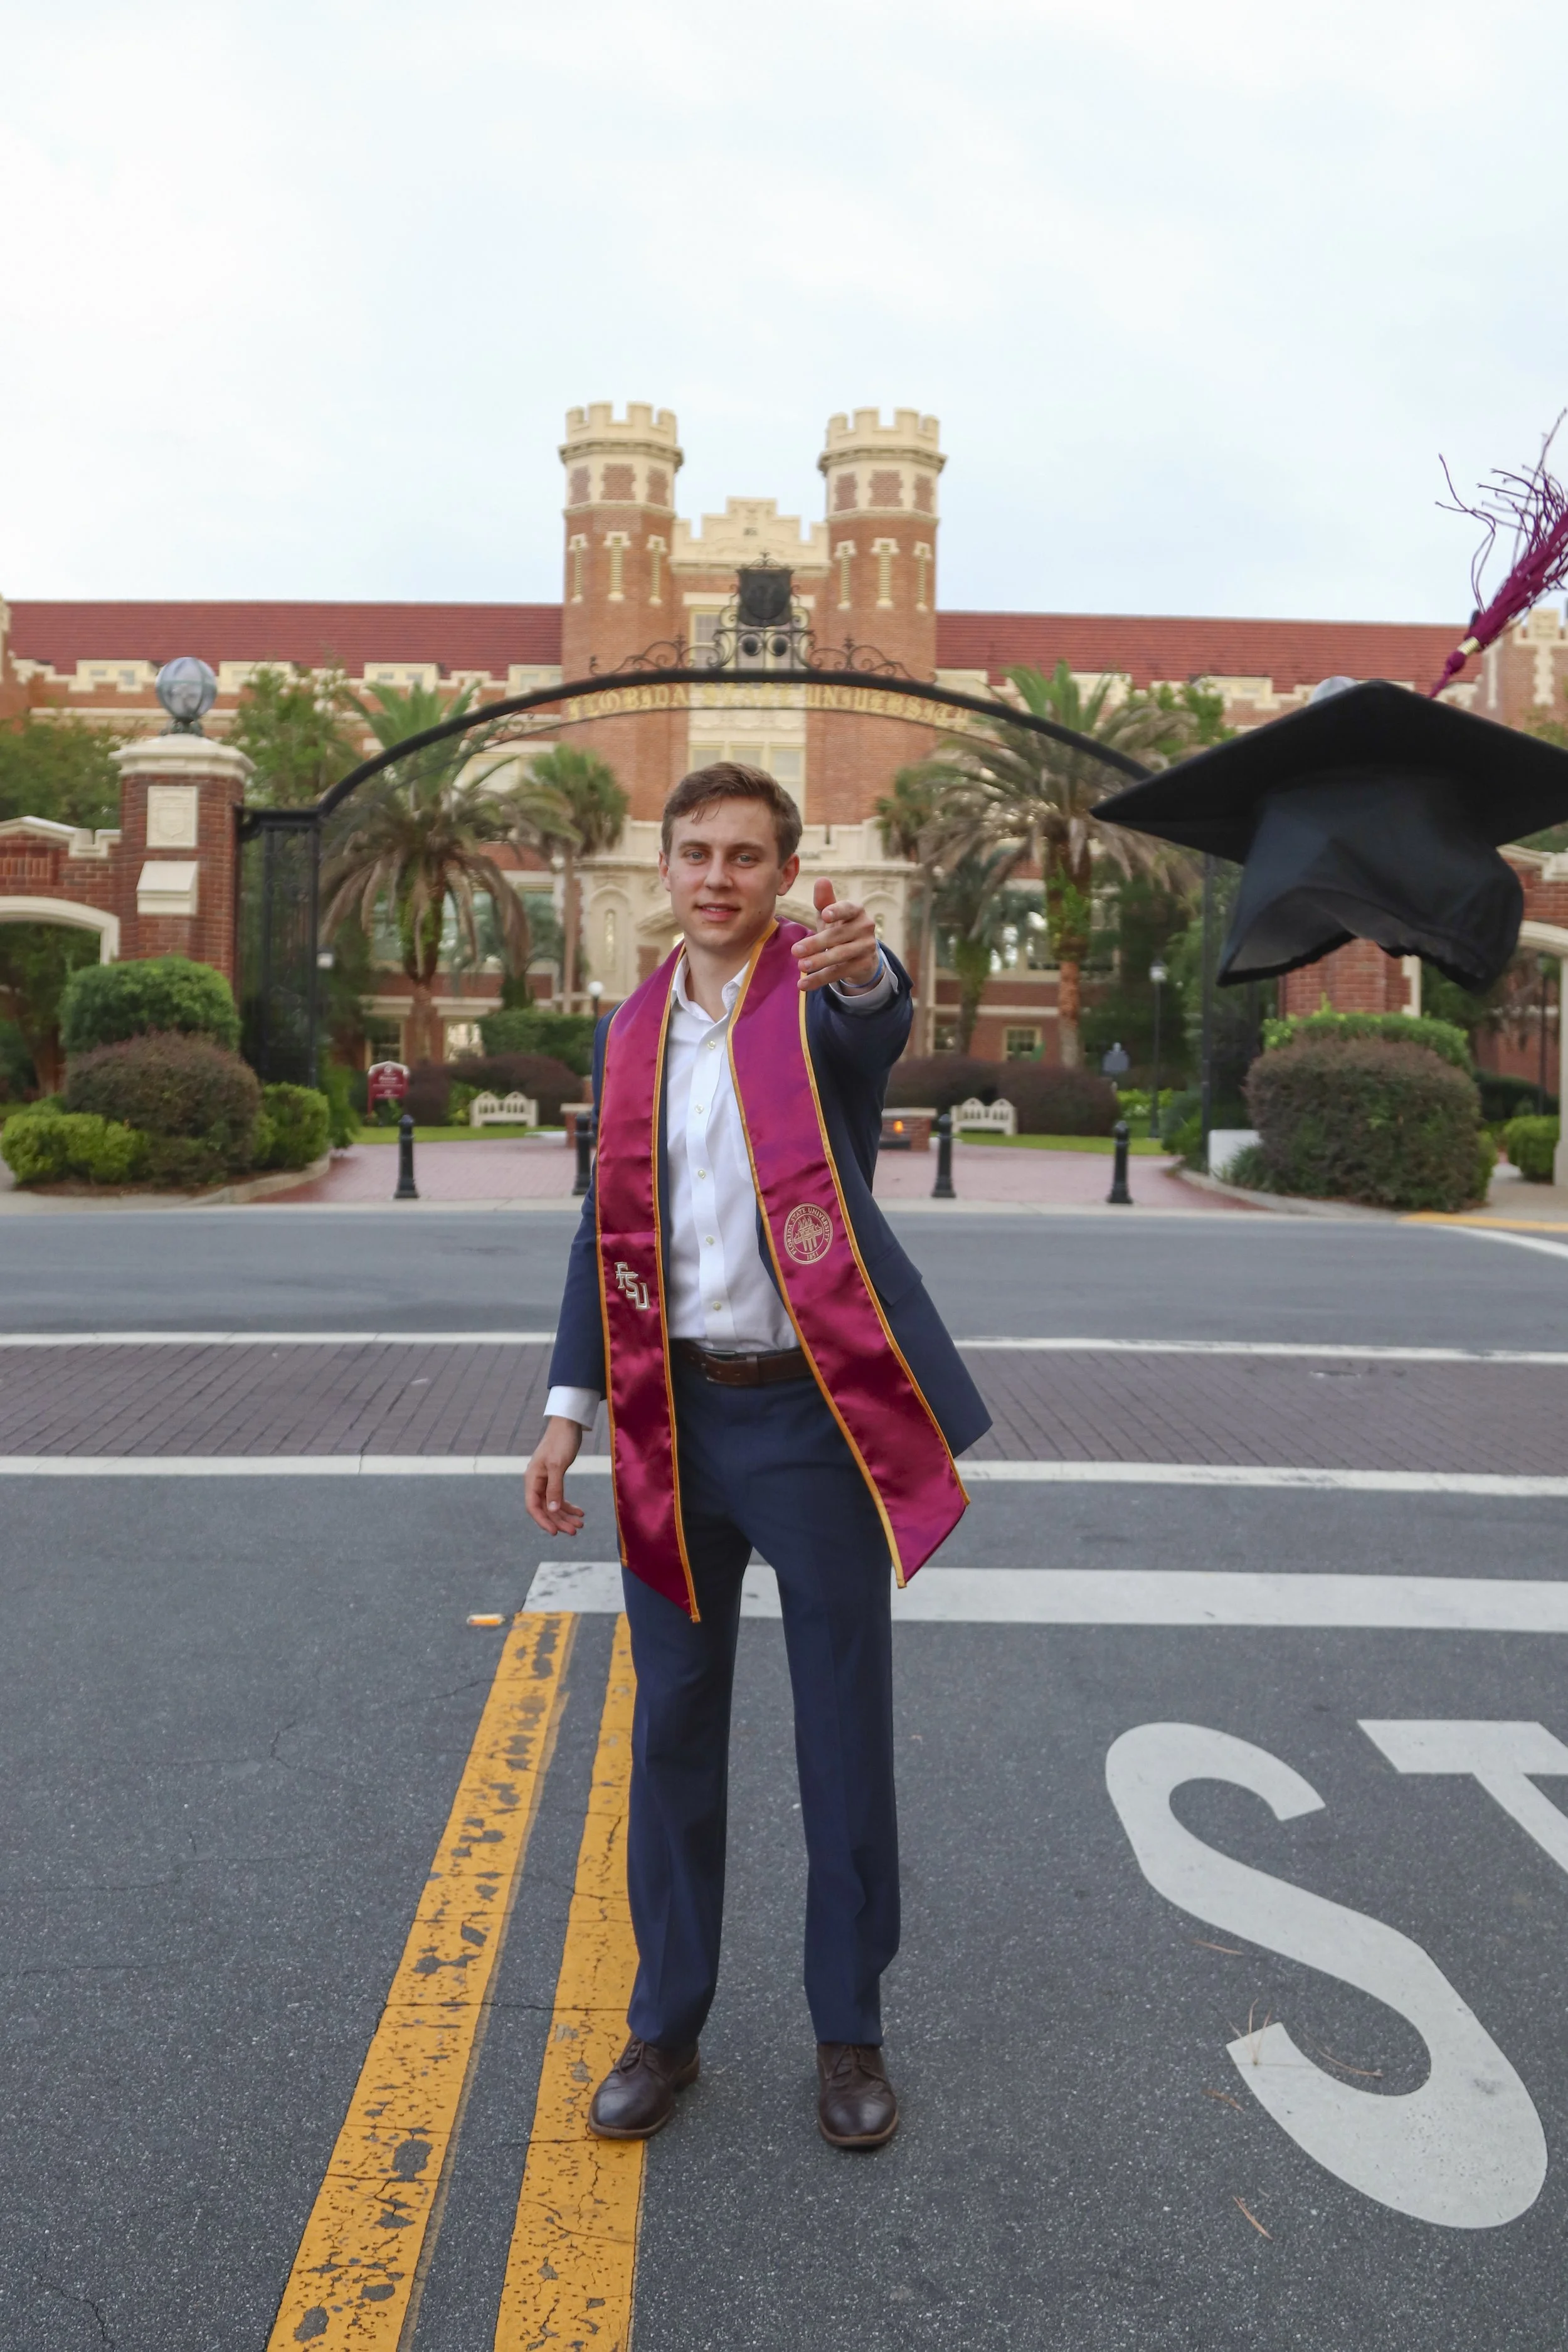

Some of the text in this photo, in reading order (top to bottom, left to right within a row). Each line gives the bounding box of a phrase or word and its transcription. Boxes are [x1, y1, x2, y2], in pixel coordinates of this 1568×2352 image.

[566, 684, 689, 721] FLORIDA
[806, 683, 969, 731] UNIVERSITY
[787, 1207, 830, 1255] FLORIDA STATE UNIVERSITY
[807, 1251, 819, 1260] 1851
[614, 1261, 650, 1310] FSU
